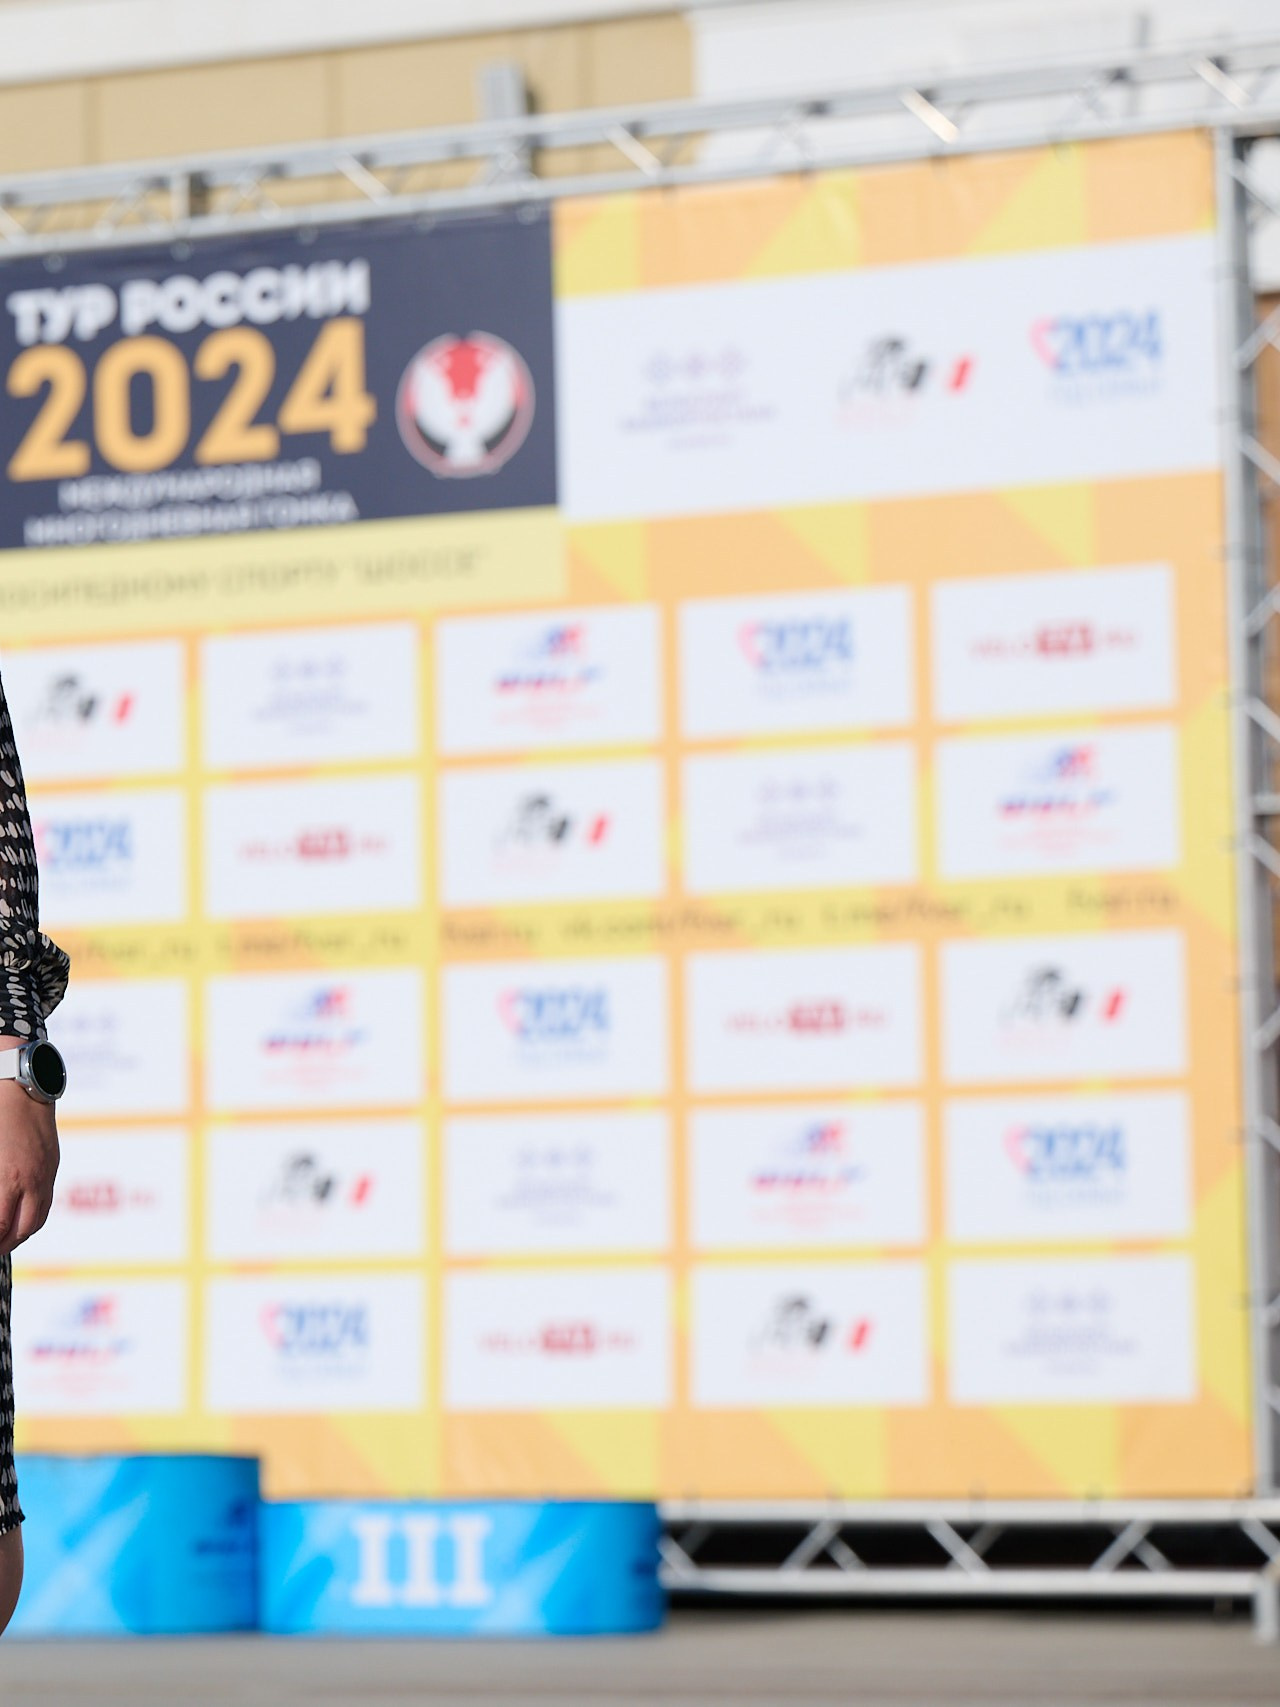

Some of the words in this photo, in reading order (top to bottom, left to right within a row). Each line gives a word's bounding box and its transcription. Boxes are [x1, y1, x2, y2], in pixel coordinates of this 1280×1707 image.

[8, 285, 117, 346] ТУР
[121, 258, 370, 337] РОССИИ
[6, 317, 377, 482] 2024
[350, 1514, 490, 1608] III
